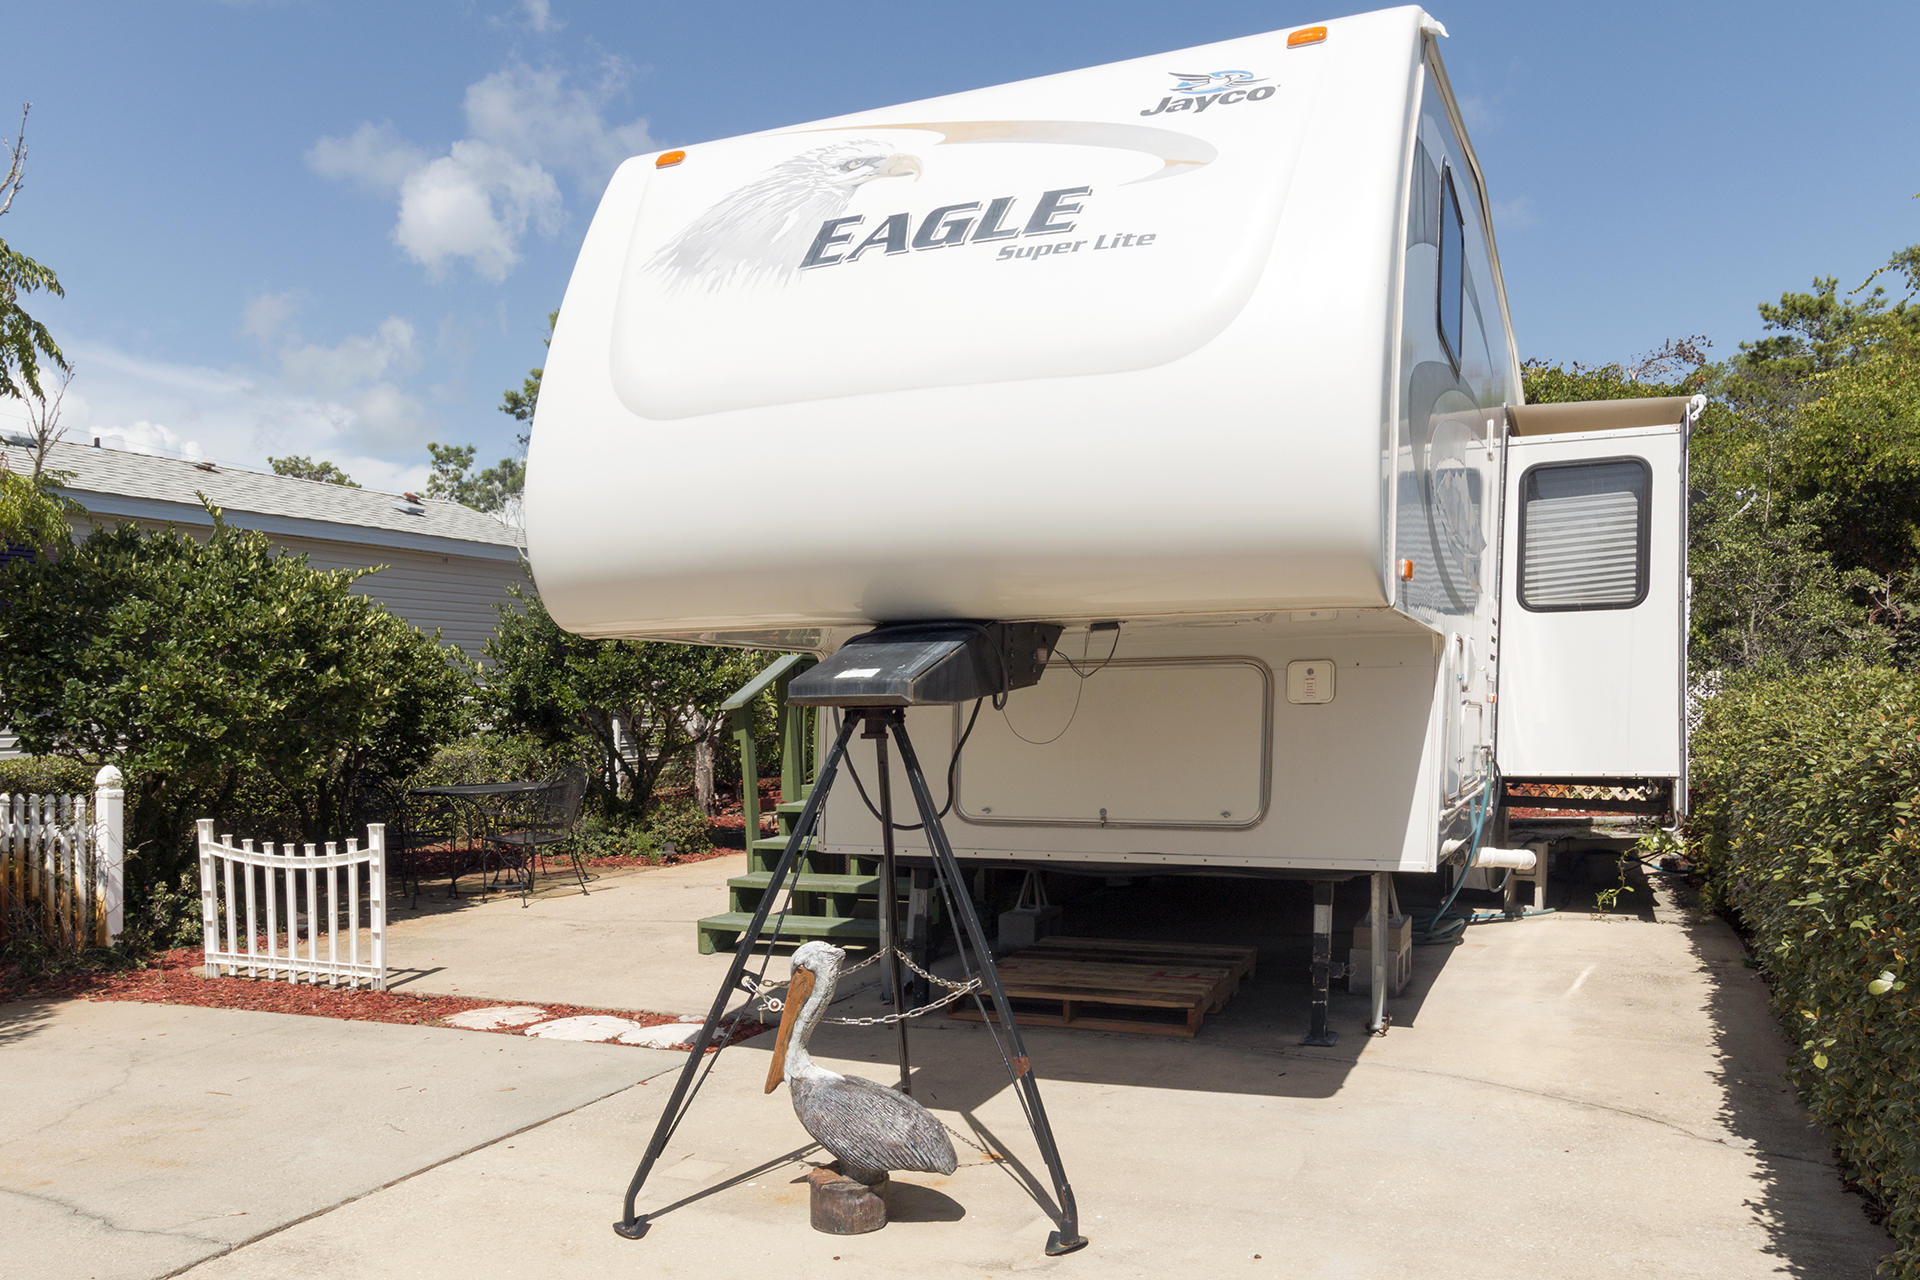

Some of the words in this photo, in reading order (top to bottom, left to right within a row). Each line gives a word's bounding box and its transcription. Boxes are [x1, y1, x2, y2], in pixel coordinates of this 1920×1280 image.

[1140, 86, 1276, 116] Jayco
[799, 185, 1093, 270] EAGLE
[996, 240, 1088, 261] Super
[1094, 233, 1157, 250] Lite
